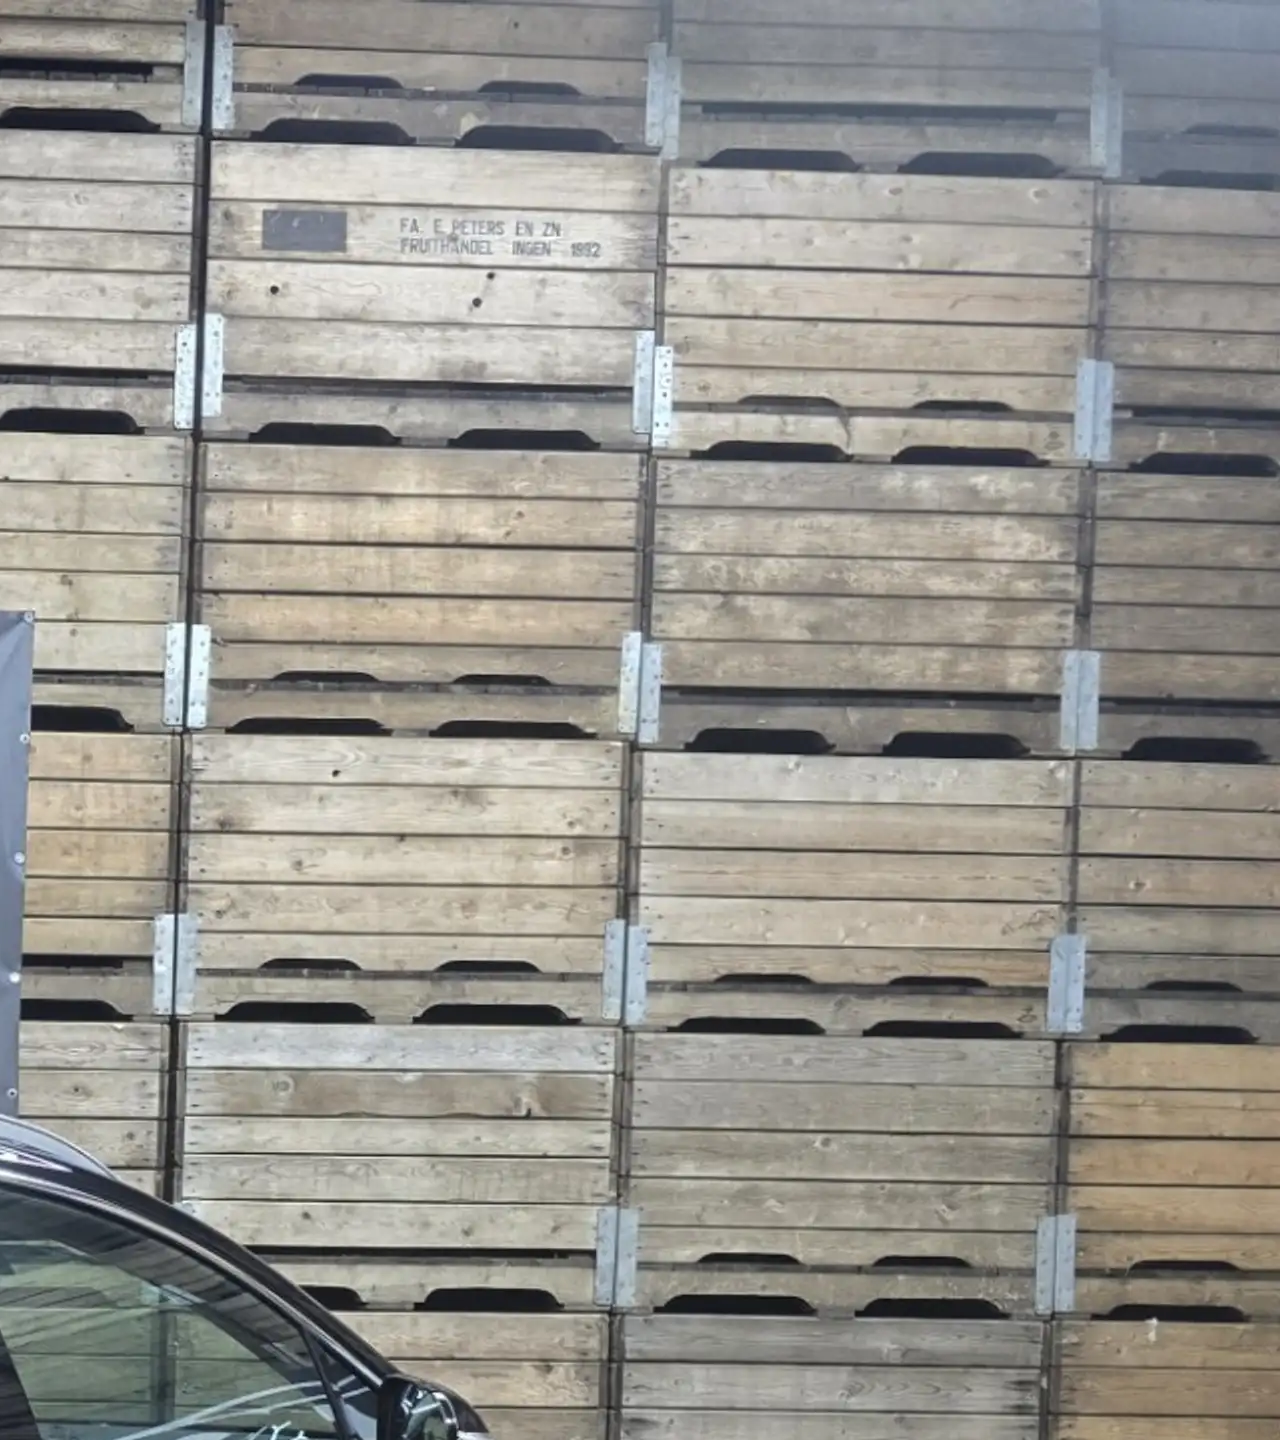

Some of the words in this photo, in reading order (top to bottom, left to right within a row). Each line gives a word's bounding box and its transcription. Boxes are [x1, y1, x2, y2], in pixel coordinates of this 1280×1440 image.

[451, 218, 506, 236] PETERS
[515, 220, 534, 237] EN
[399, 237, 494, 256] FRUITHANDEL
[511, 240, 552, 257] INGEN
